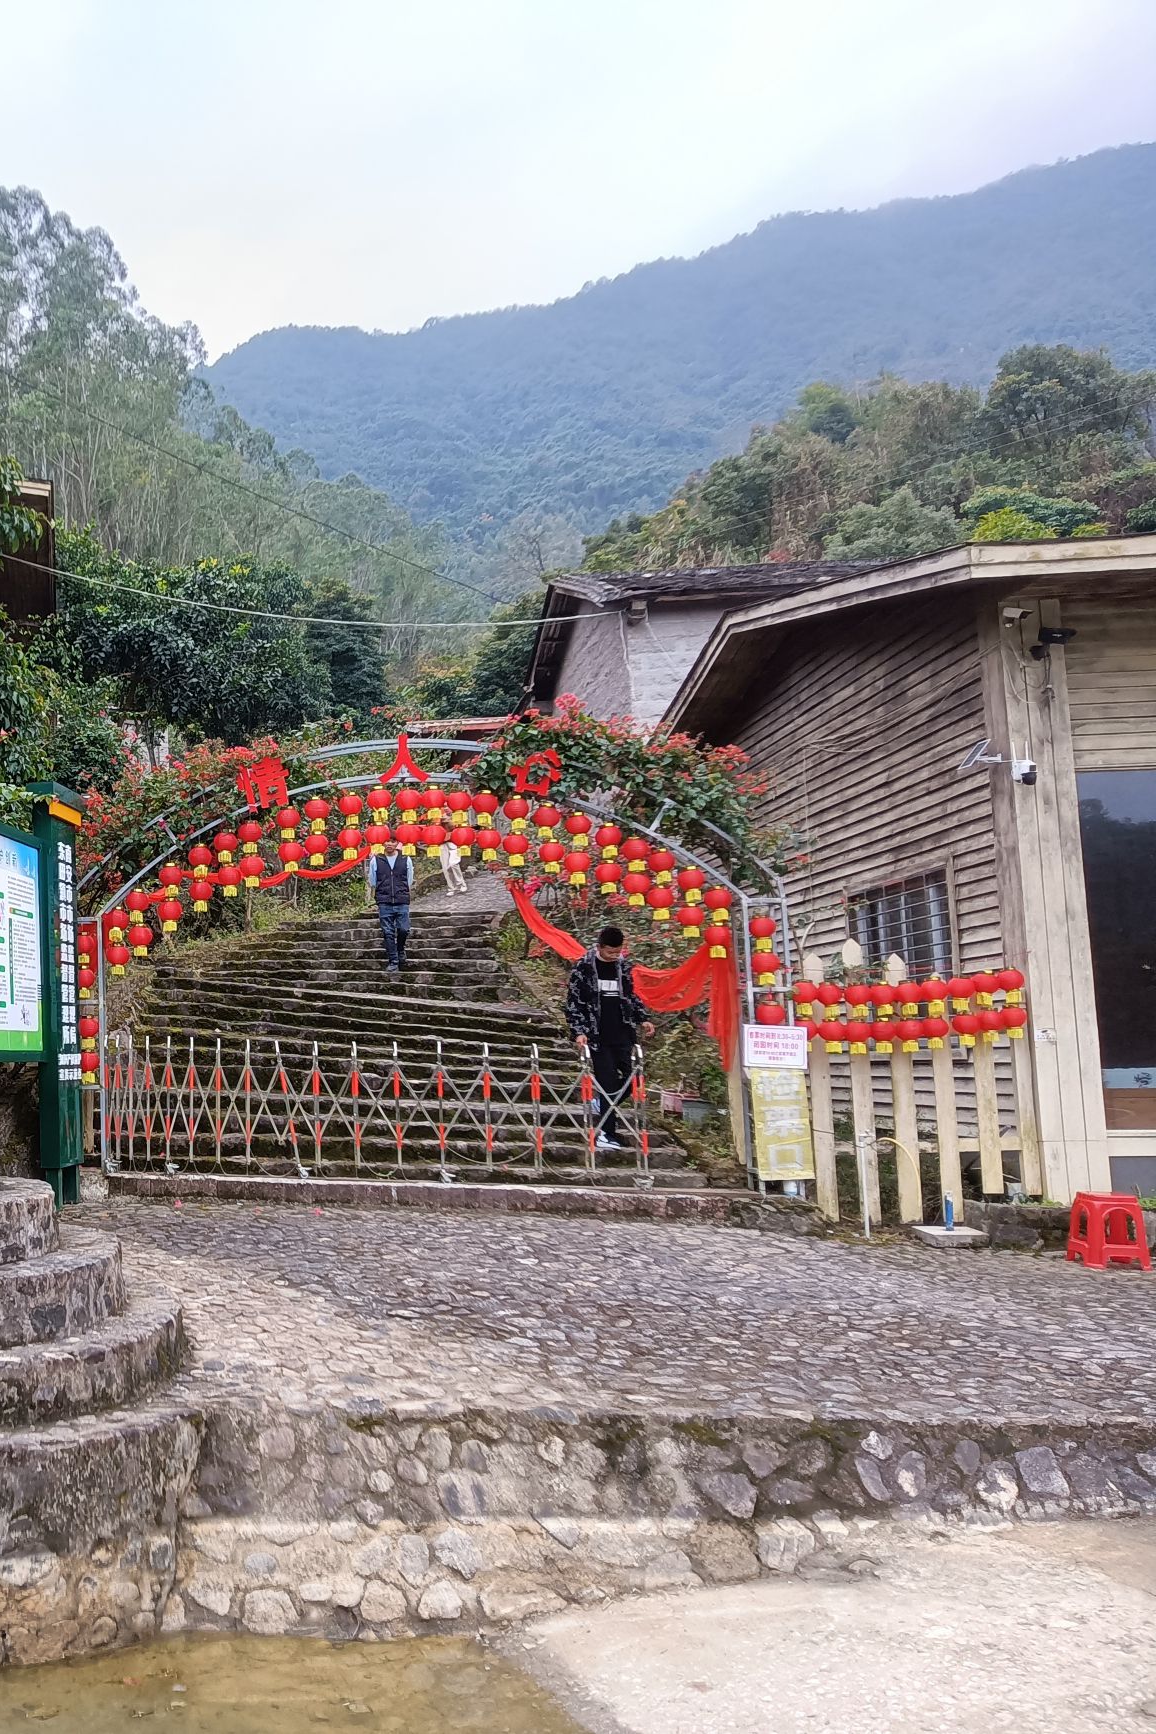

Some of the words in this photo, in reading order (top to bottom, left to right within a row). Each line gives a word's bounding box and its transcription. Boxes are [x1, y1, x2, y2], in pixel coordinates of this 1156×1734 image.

[781, 1042, 799, 1050] 18:00
[756, 1069, 805, 1170] 检票口
